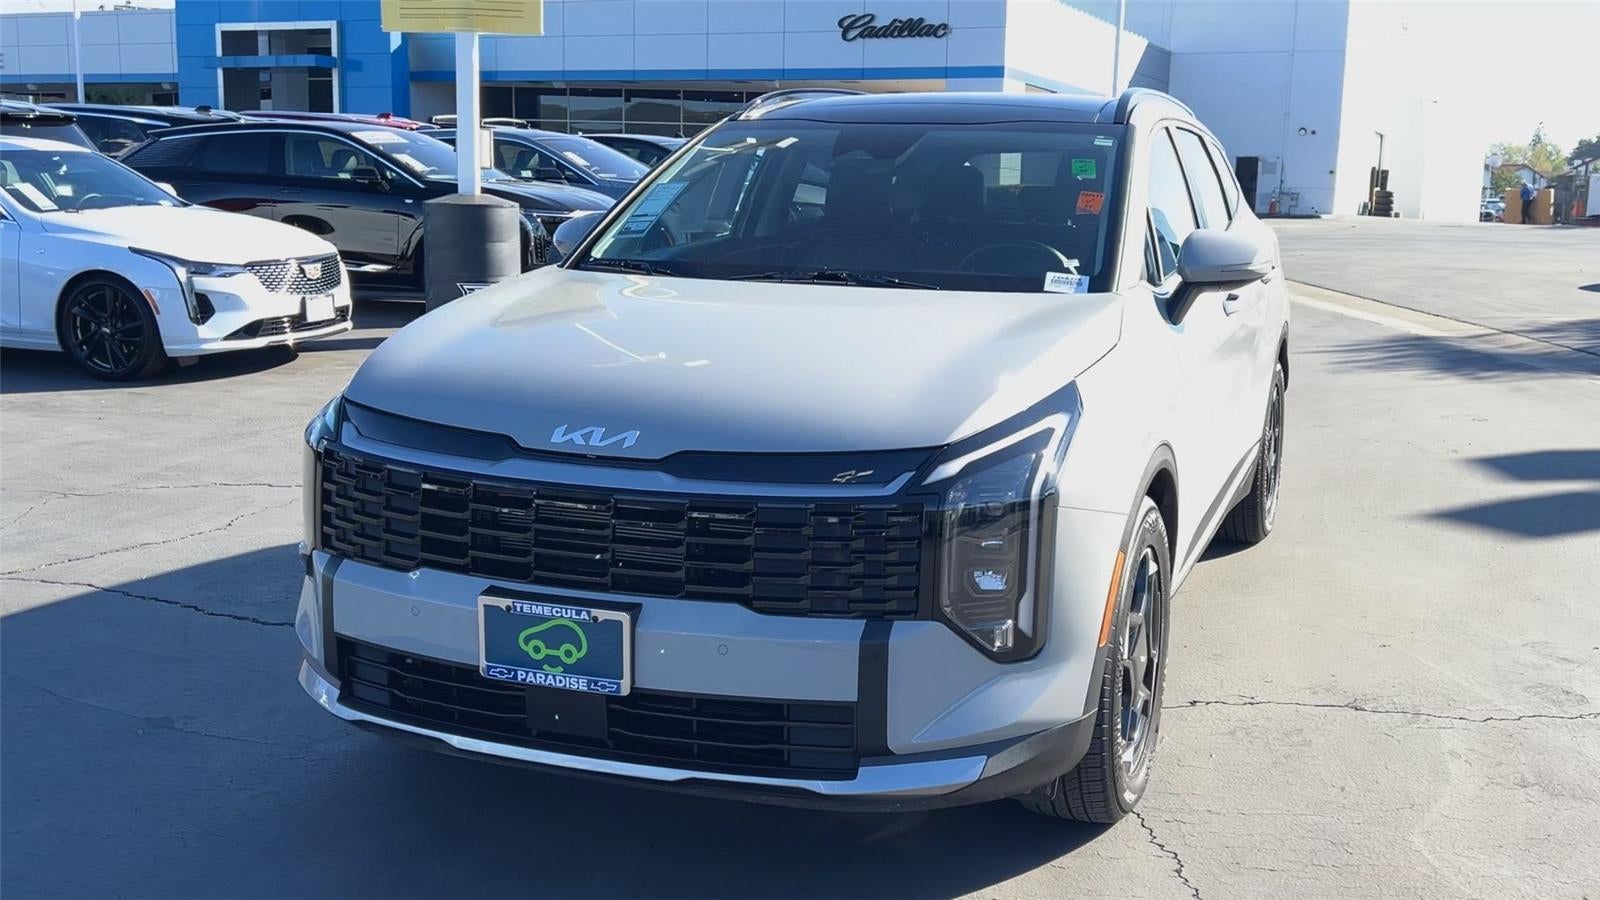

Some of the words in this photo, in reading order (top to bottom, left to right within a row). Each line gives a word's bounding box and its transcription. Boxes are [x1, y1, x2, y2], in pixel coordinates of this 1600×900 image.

[838, 13, 951, 42] Cadillac
[550, 424, 640, 449] KIA
[514, 602, 590, 621] TEMECULA
[517, 670, 588, 690] PARADISE
